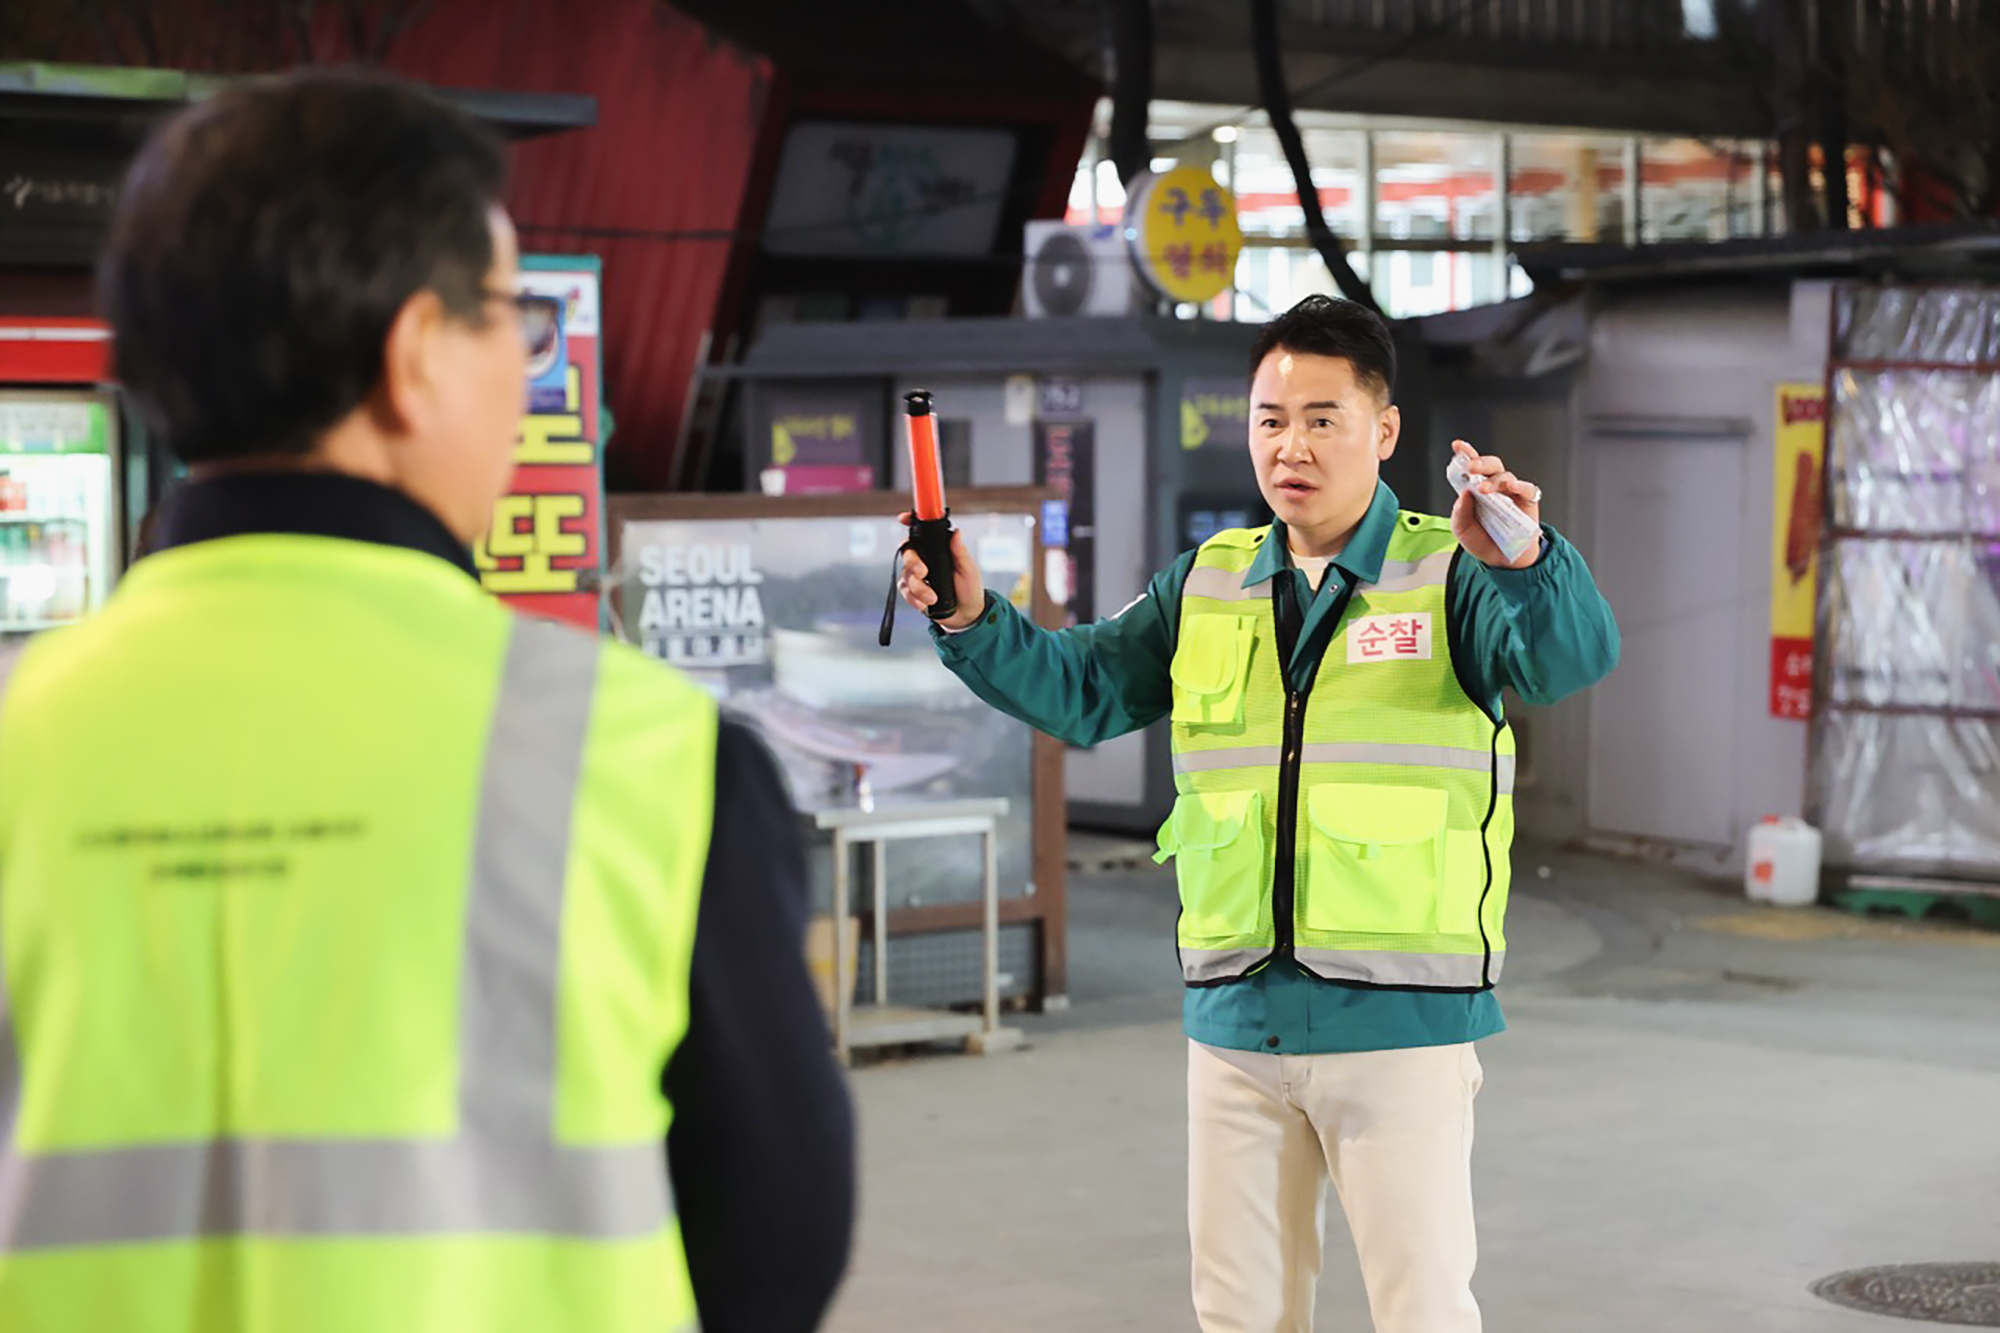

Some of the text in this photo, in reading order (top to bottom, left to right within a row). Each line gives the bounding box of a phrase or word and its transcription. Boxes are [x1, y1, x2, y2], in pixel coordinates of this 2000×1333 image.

[1158, 186, 1227, 229] 구두
[639, 543, 764, 586] SEOUL
[638, 584, 765, 630] ARENA
[1357, 618, 1423, 657] 순찰
